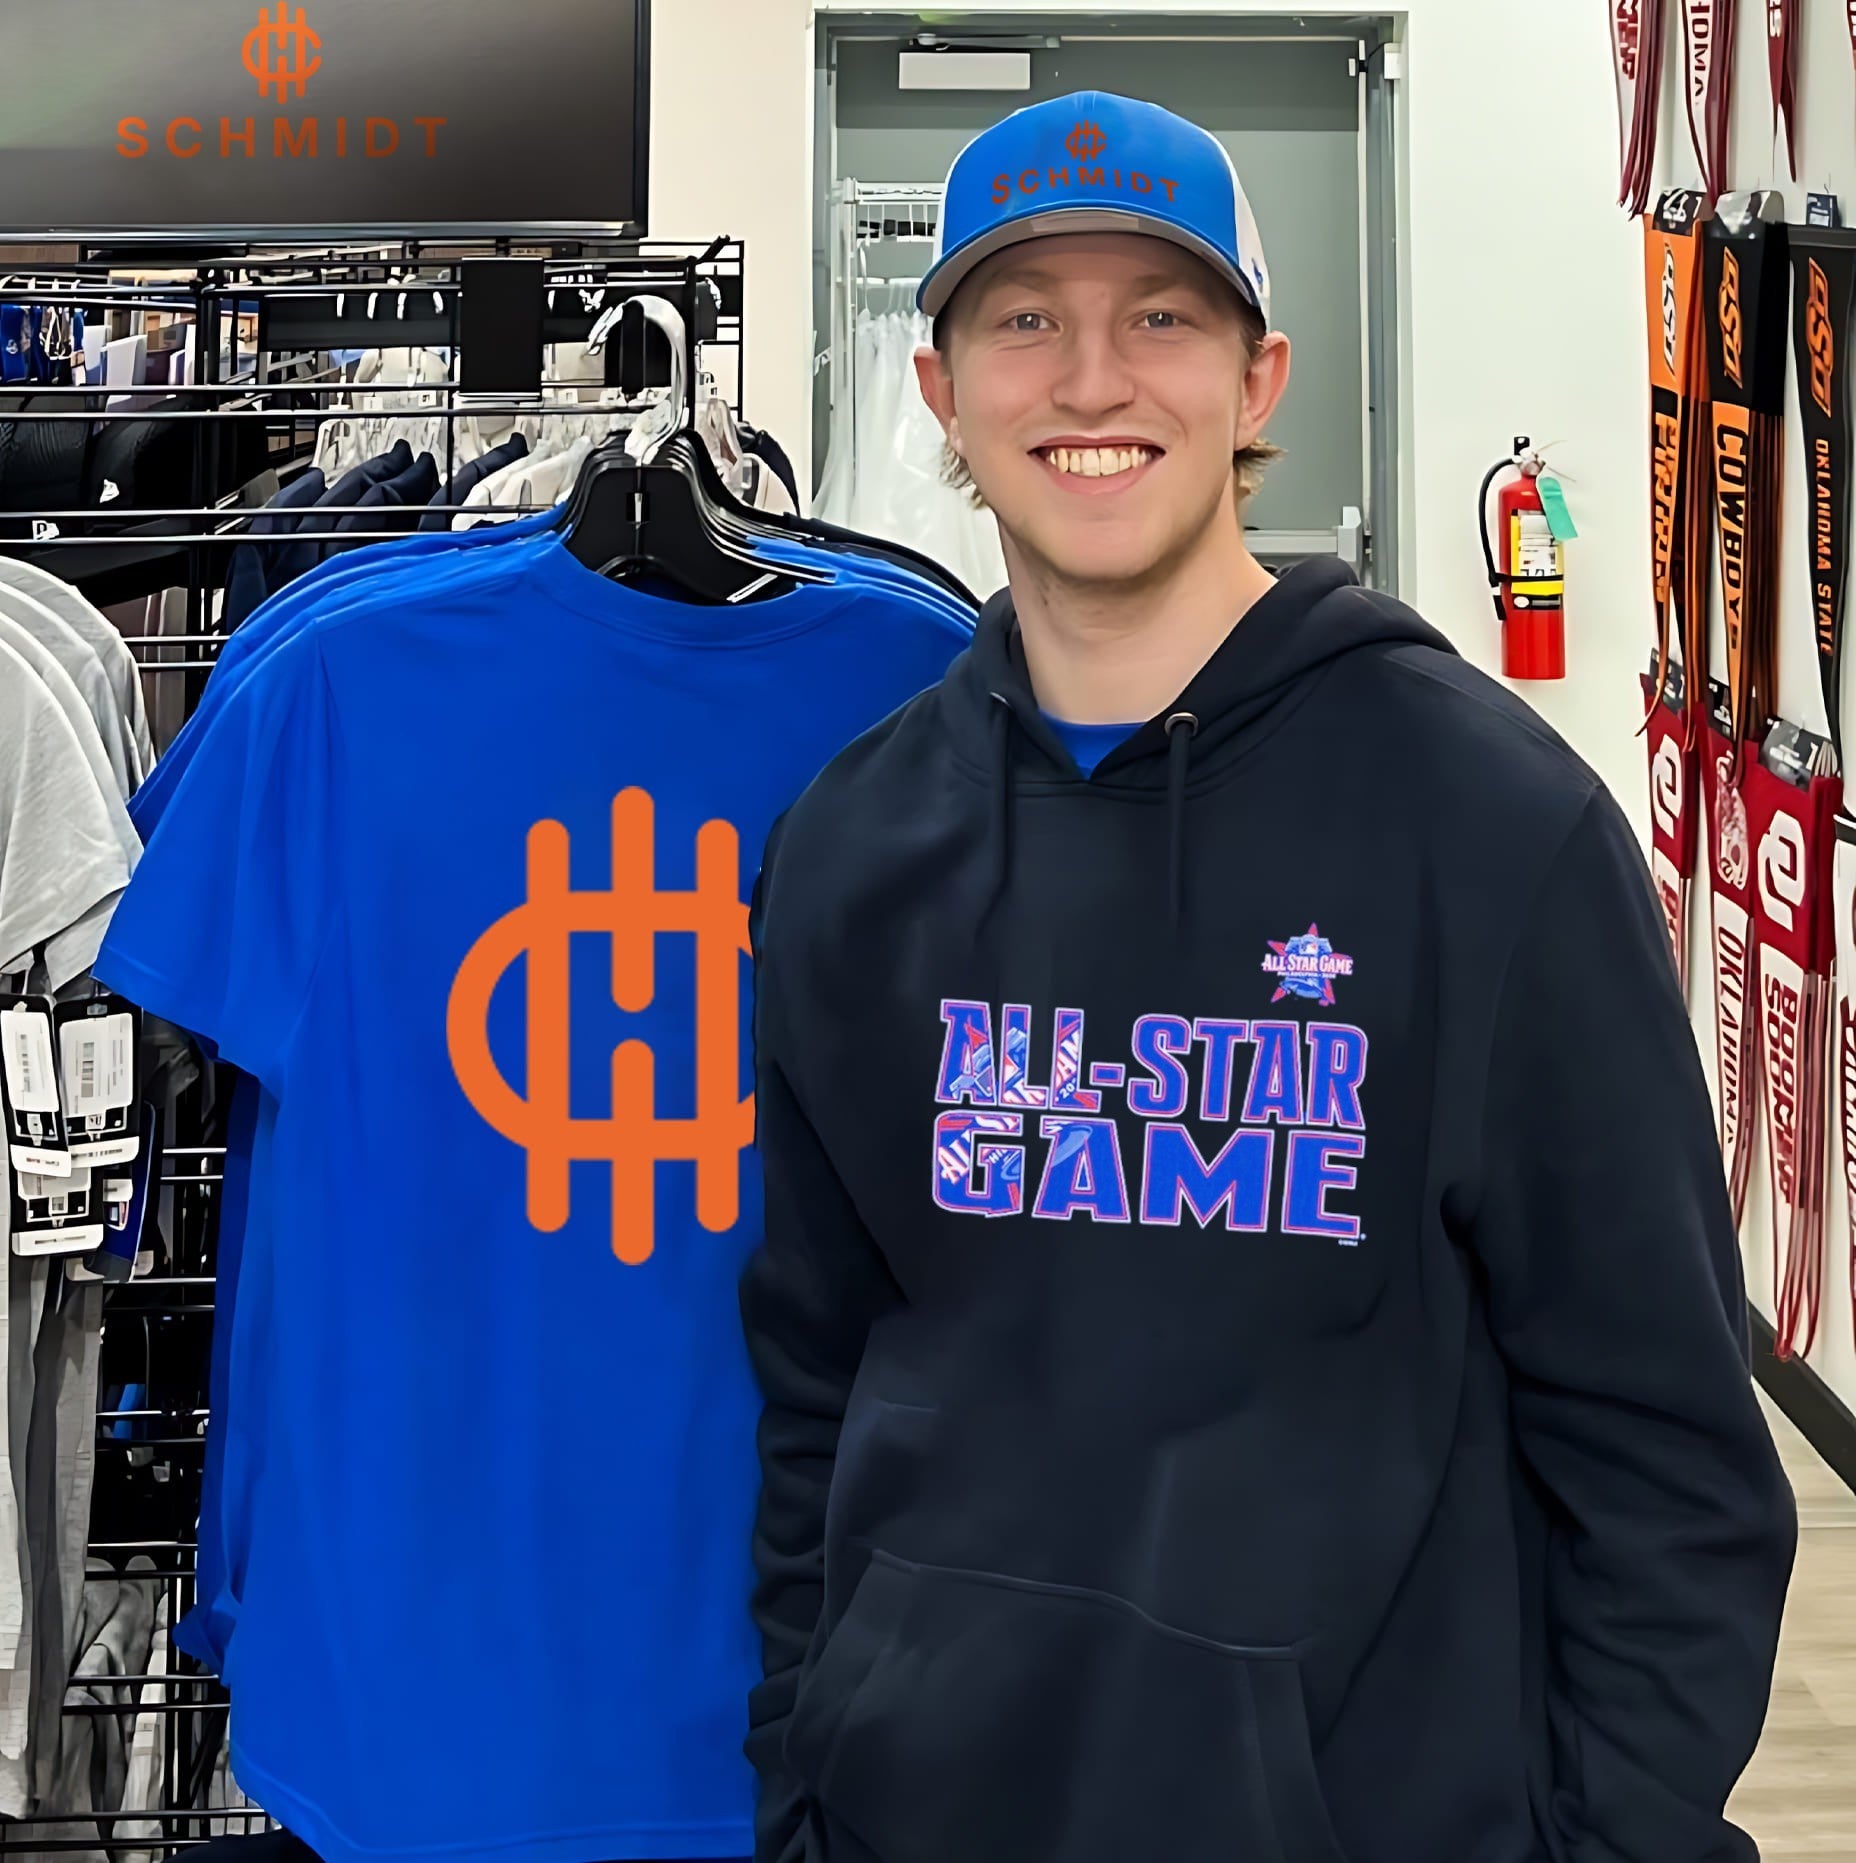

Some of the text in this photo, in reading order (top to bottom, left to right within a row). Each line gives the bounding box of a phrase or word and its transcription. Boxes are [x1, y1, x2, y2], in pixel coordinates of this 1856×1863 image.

[115, 116, 447, 158] SCHMIDT
[991, 167, 1179, 204] SCHMIDT
[1815, 439, 1831, 570] OKLAHOMA
[1261, 953, 1353, 975] ALL STAR GAME
[935, 998, 1368, 1130] ALL-STAR
[932, 1109, 1366, 1239] GAME
